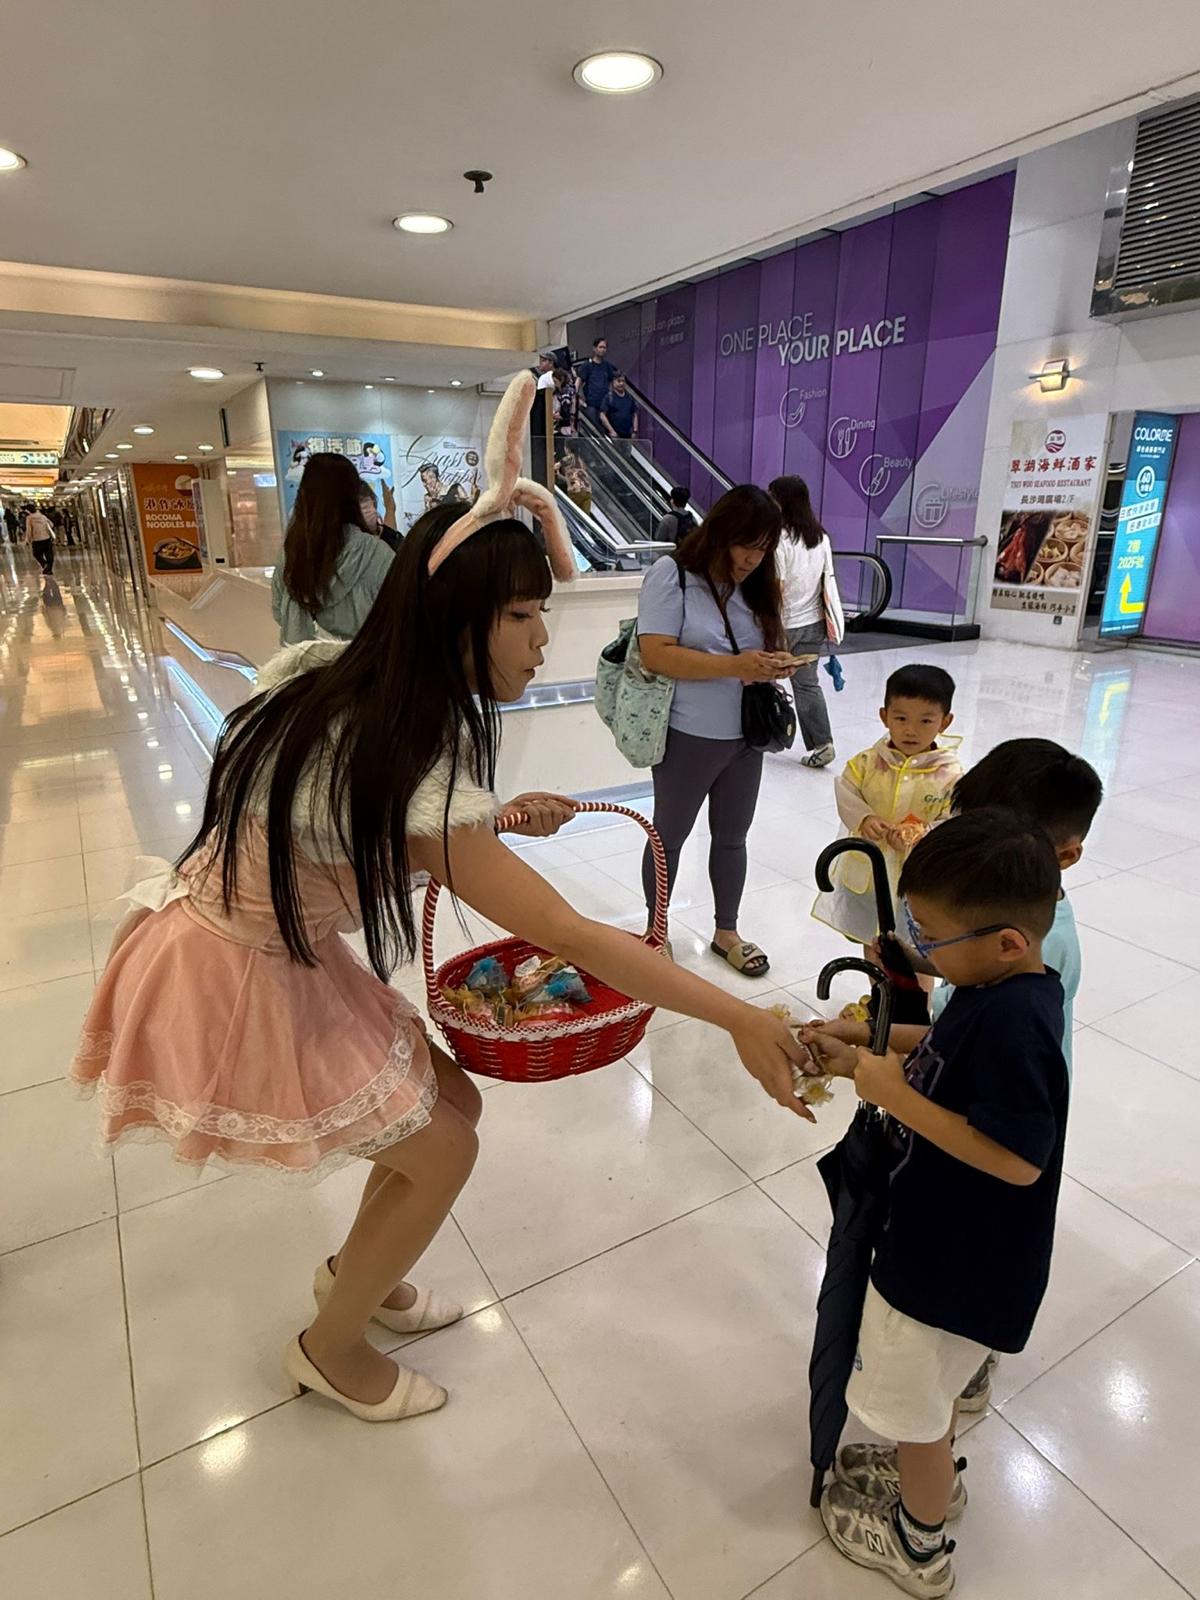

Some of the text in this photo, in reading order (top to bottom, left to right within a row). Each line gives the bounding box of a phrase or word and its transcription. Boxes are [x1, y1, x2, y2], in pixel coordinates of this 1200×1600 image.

[720, 328, 754, 356] ONE
[758, 312, 813, 348] PLACE
[779, 316, 906, 366] YOUR PLACE
[800, 388, 827, 400] Fashion
[851, 418, 876, 431] Dining
[884, 456, 913, 468] Beauty
[1057, 478, 1092, 487] RESTAURANT
[865, 1530, 885, 1556] N
